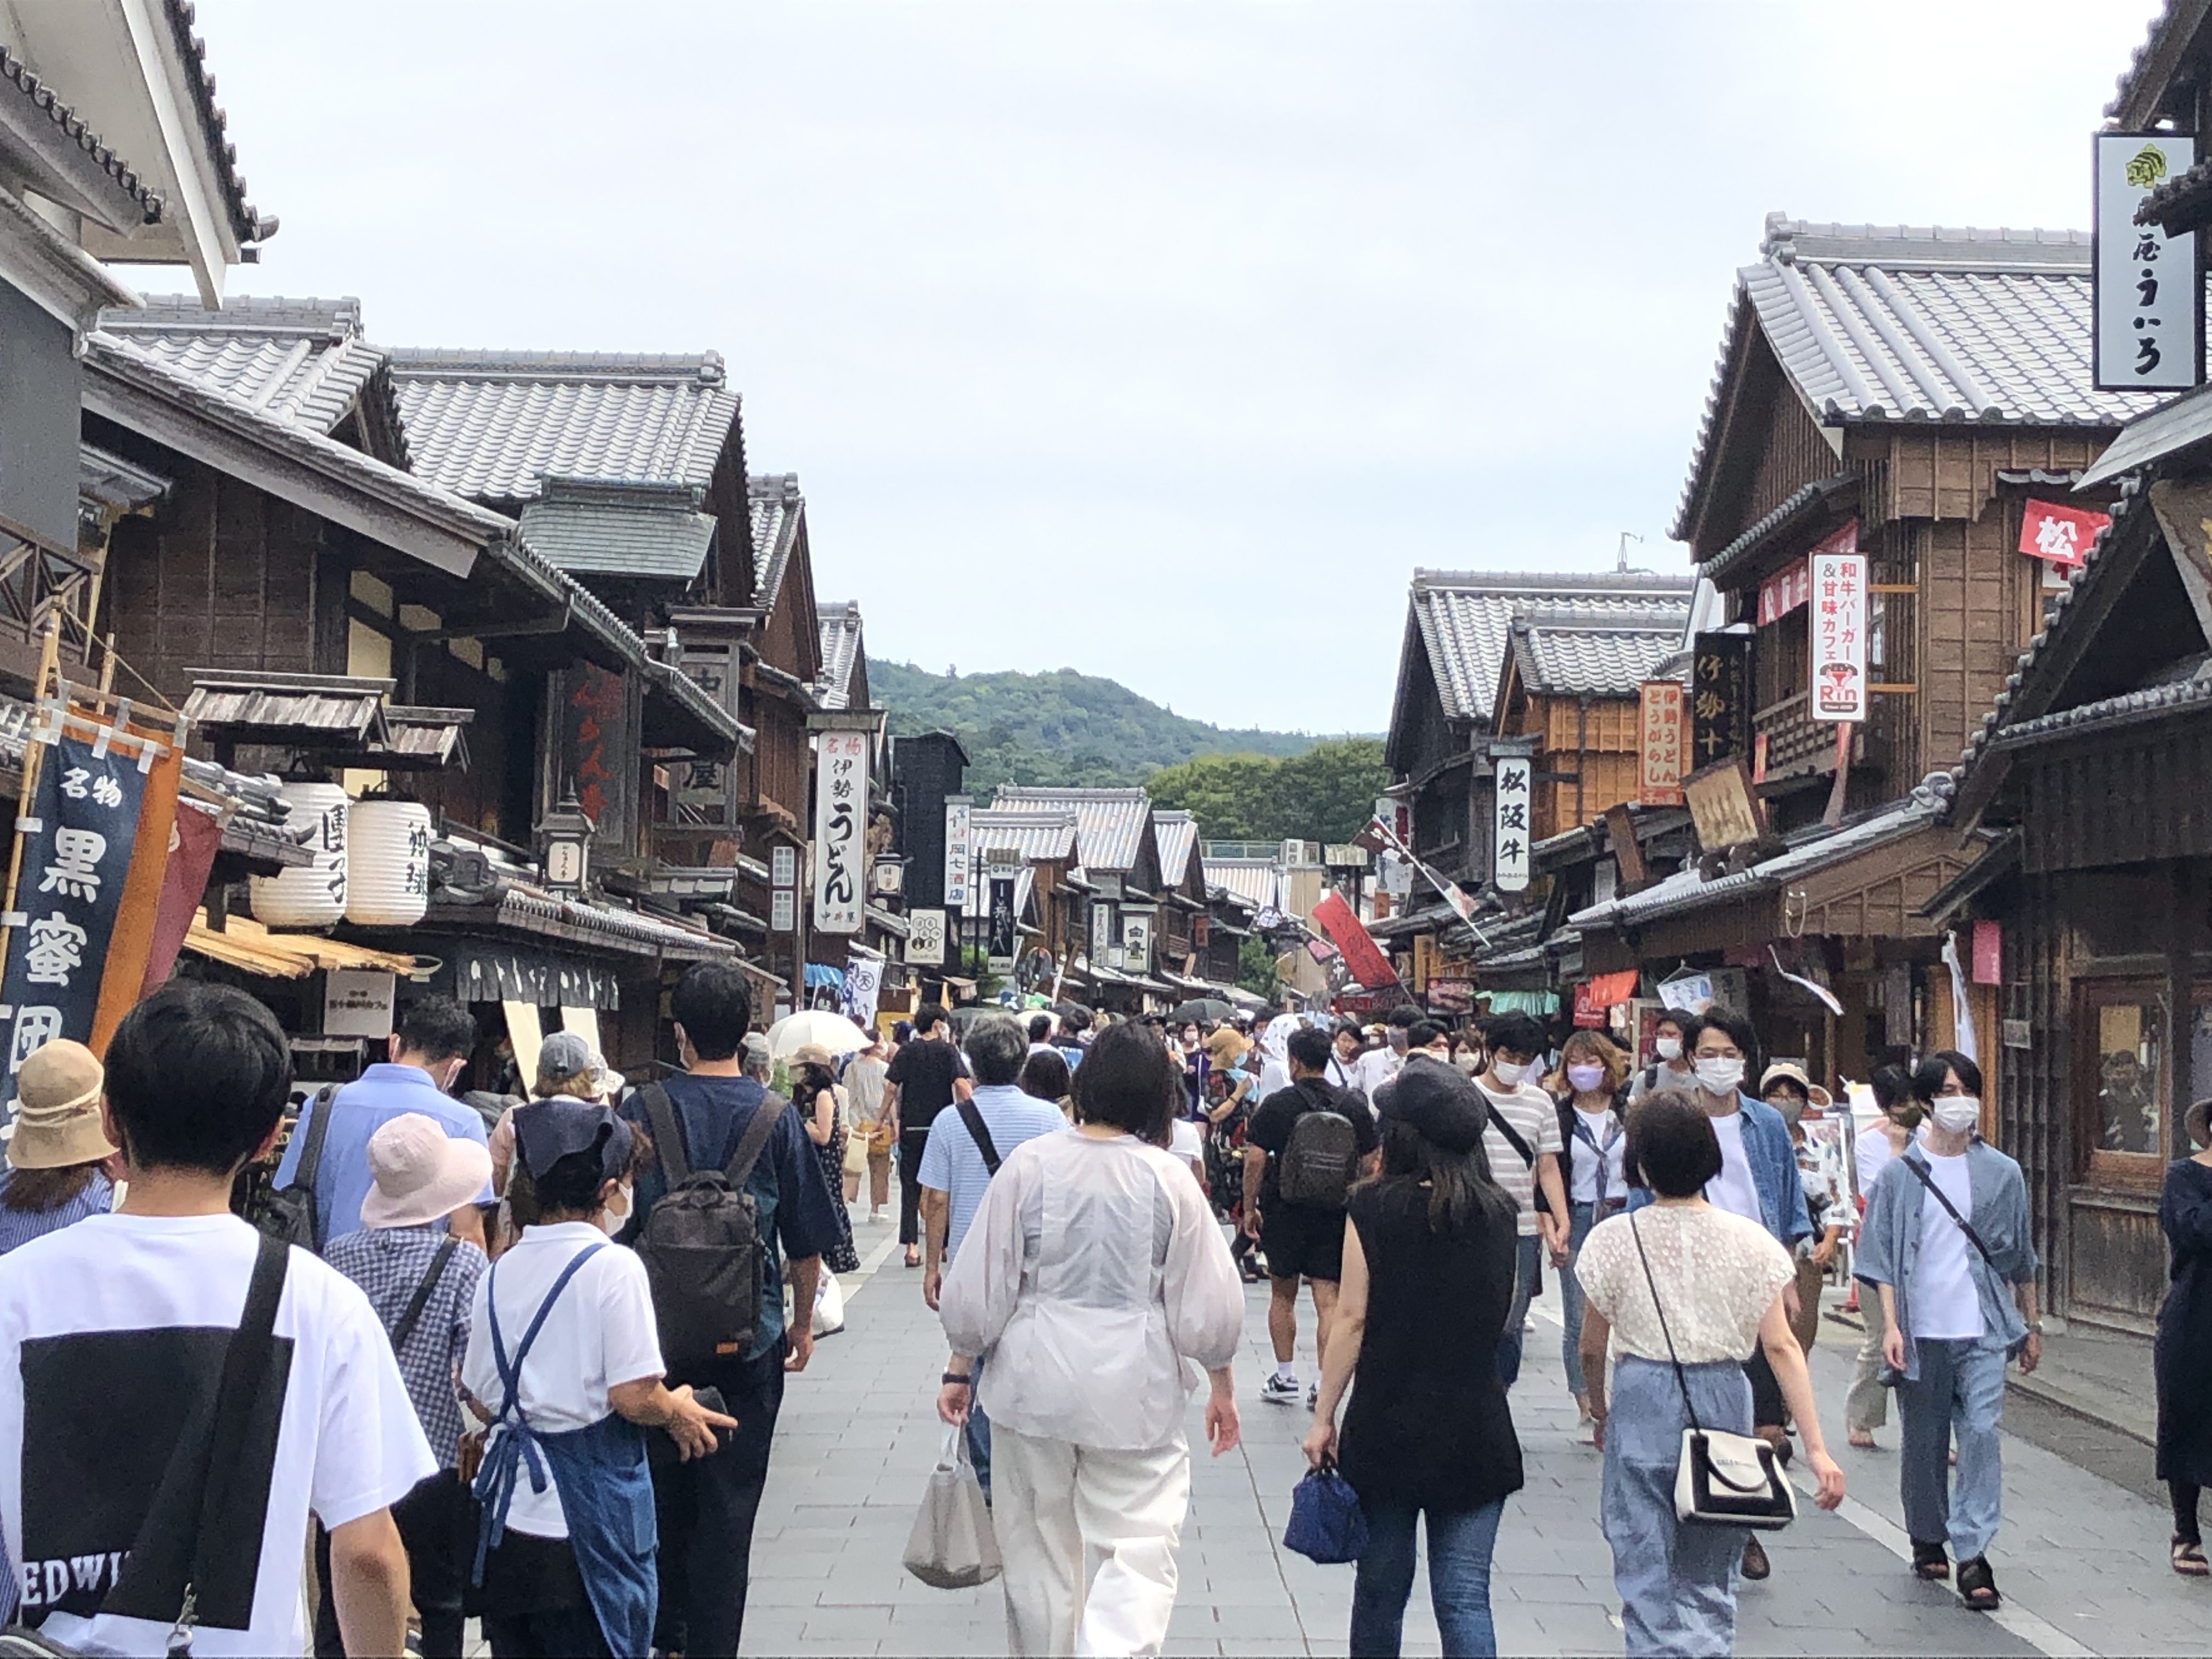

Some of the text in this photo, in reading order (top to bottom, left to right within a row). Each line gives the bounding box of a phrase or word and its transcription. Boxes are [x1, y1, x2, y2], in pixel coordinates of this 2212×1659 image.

[2132, 198, 2161, 375] 屋ういろ
[2035, 516, 2078, 558] 松
[1821, 562, 1838, 660] &甘味カフェ
[1839, 562, 1857, 661] 和牛バーガー
[825, 737, 861, 756] 名物
[1648, 689, 1662, 783] とうがらし
[1663, 689, 1678, 783] 伊勢うどん
[60, 766, 122, 808] 名物
[825, 758, 854, 905] 伊勢うどん
[1499, 766, 1527, 865] 松阪牛
[1, 825, 107, 1140] 黒蜜団
[20, 1550, 131, 1605] EDWI
